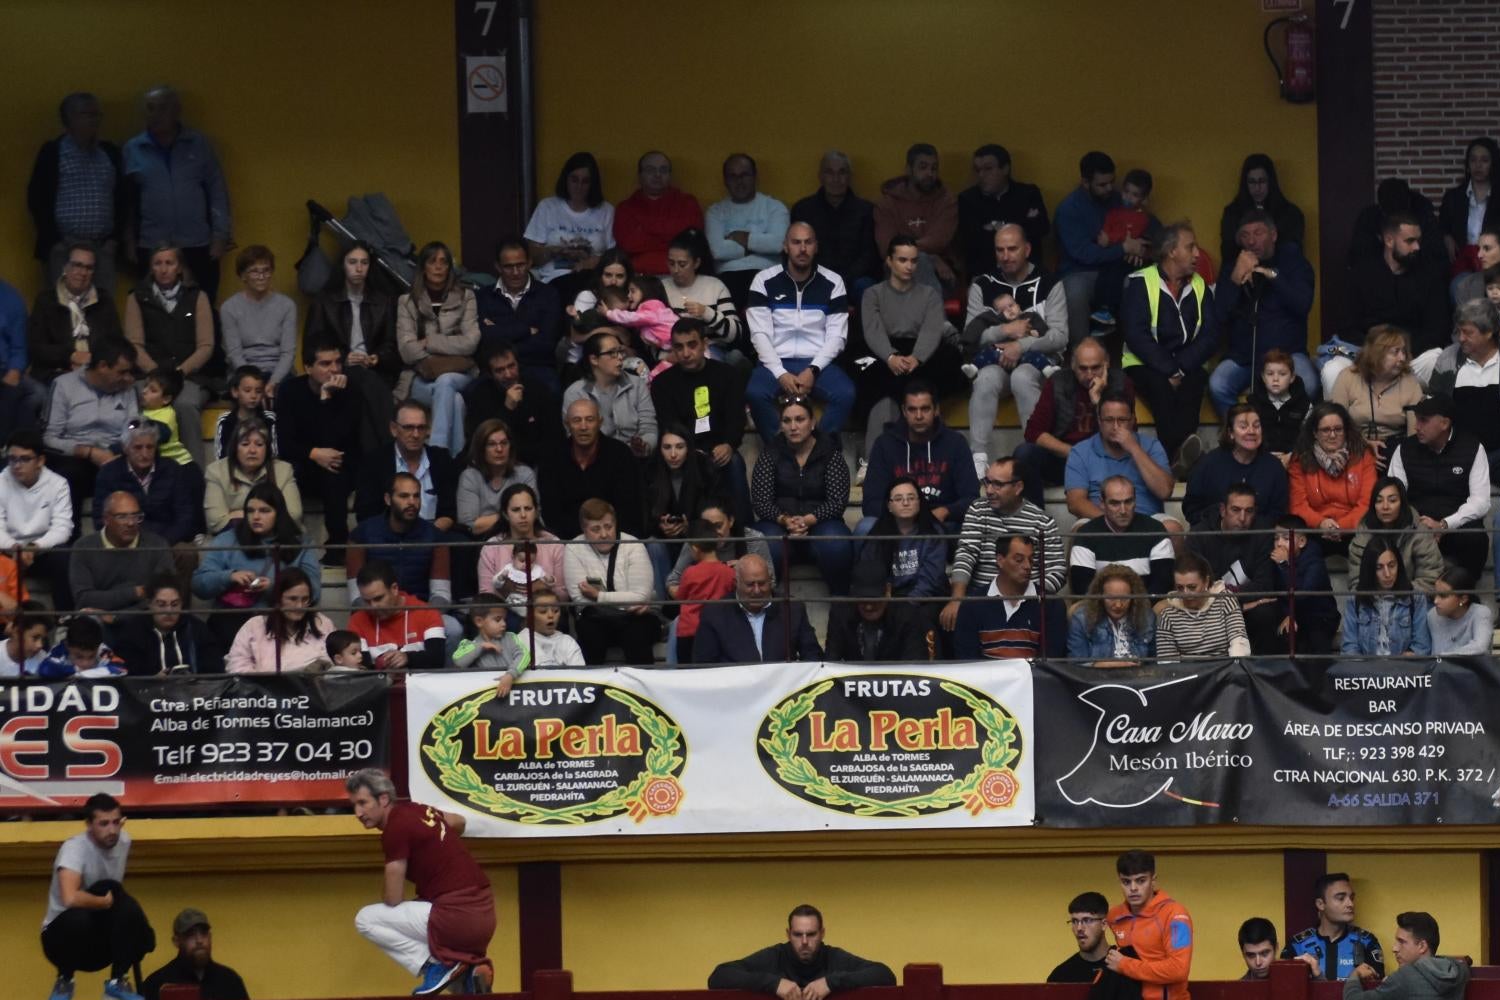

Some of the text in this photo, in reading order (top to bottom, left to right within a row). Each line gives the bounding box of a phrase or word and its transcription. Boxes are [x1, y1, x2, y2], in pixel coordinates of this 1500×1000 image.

[473, 1, 497, 36] 7
[1332, 0, 1356, 30] 7
[844, 680, 931, 698] FRUTAS
[1334, 674, 1432, 690] RESTAURANTE
[0, 685, 119, 712] IDAD
[150, 699, 190, 712] Ctra:
[193, 695, 277, 711] Peñaranda
[509, 686, 596, 707] FRUTAS
[1368, 699, 1397, 713] BAR
[150, 710, 374, 732] Alba de Tormes (Salamanca)
[1105, 711, 1254, 744] Casa Marco
[1283, 720, 1485, 737] ÁREA DE DESCANSO PRIVADA
[473, 713, 644, 761] La Perla
[809, 707, 980, 752] La Perla
[152, 739, 373, 766] Telf 923 37 04 30
[853, 753, 930, 762] ALBA de TORMES
[1109, 748, 1253, 771] Mesón Ibérico
[1360, 746, 1386, 760] 923
[1390, 745, 1415, 759] 398
[1418, 744, 1445, 758] 429
[518, 760, 595, 770] ALBA de TORMES
[829, 763, 954, 773] CARBAJOSA de la SAGRADA
[494, 769, 619, 781] CARBAJOSA de la SAGRADA
[830, 775, 841, 783] EL
[842, 773, 886, 783] ZURGUÉN
[1273, 769, 1310, 782] CTRA
[1313, 770, 1389, 783] NACIONAL
[1392, 768, 1421, 782] 630.
[1425, 768, 1452, 782] P.K.
[1456, 768, 1483, 782] 372
[495, 783, 506, 791] EL
[507, 782, 551, 791] ZURGUÉN
[865, 783, 920, 794] PIEDRAHÍTA
[530, 791, 585, 801] PIEDRAHÍTA
[1327, 791, 1440, 807] A-66 SALIDA 371
